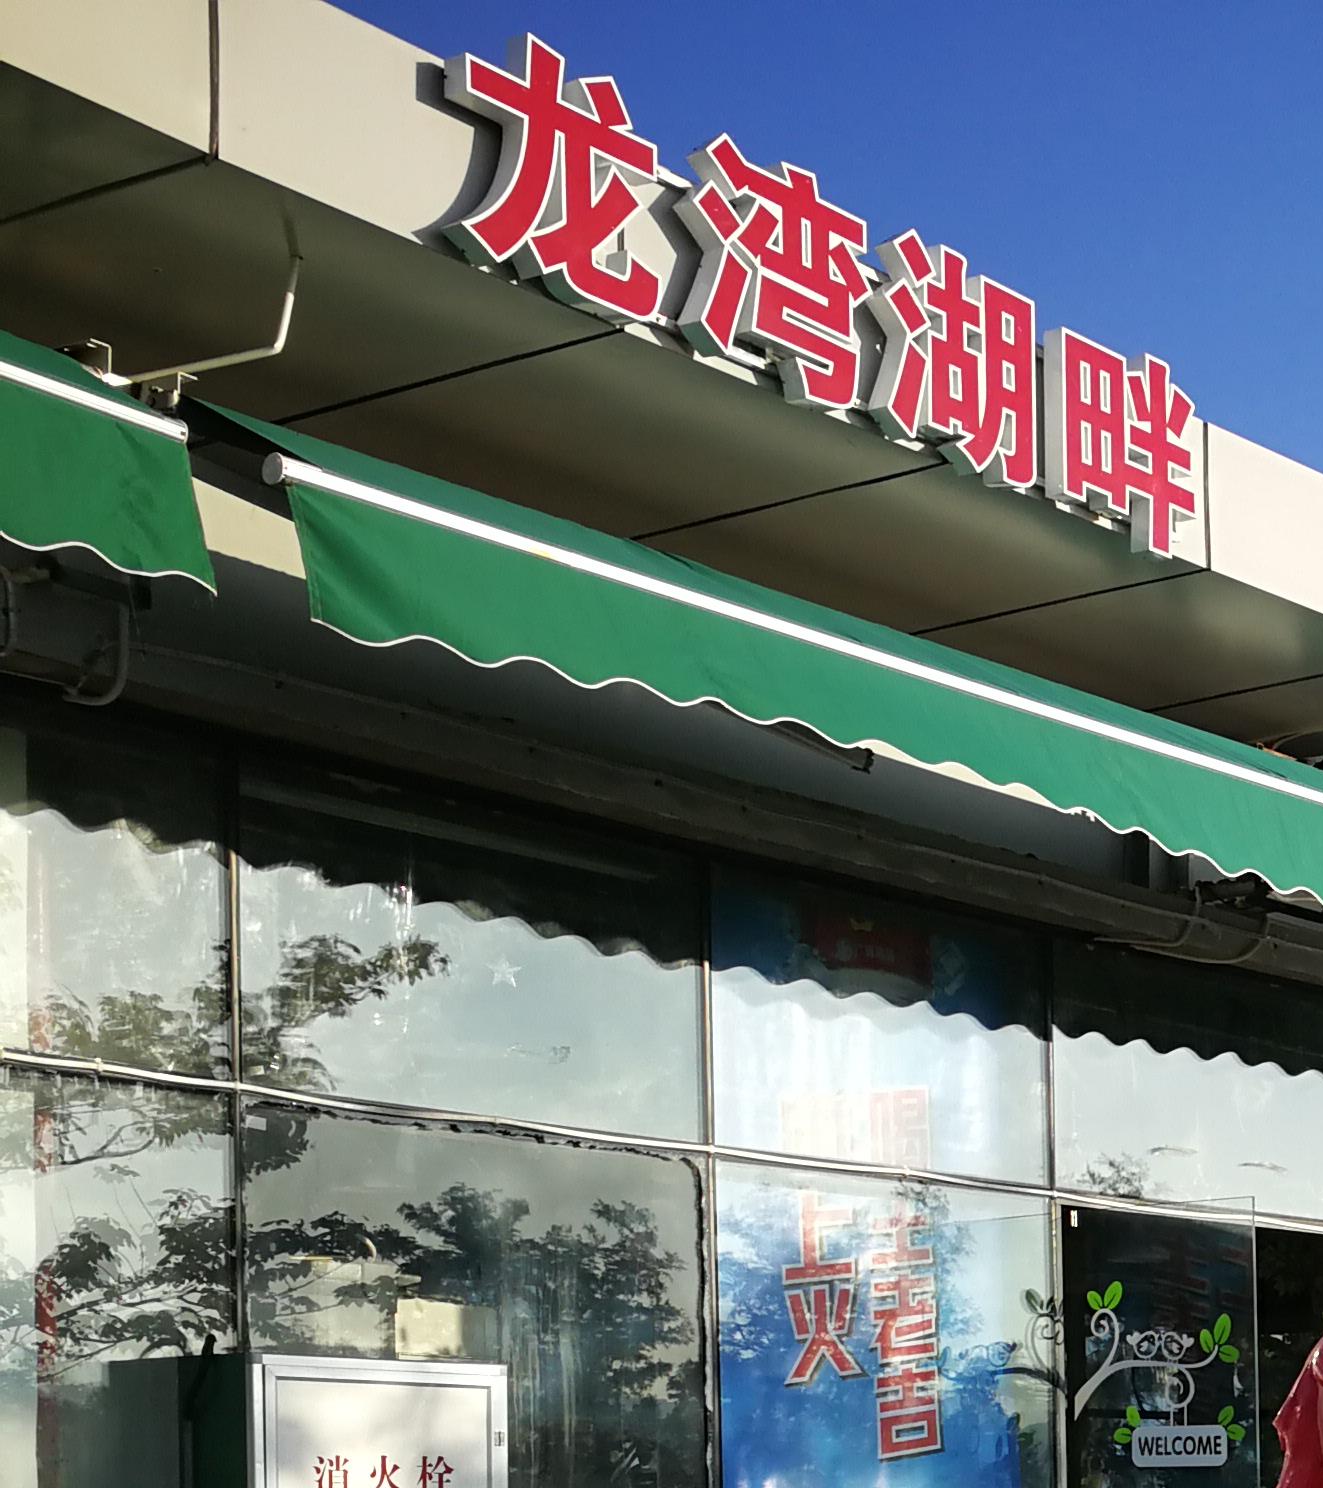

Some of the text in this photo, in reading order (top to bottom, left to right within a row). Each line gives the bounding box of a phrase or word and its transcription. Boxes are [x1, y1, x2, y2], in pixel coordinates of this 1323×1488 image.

[464, 32, 1197, 559] 龙湾湖畔
[780, 1100, 868, 1386] 上火
[1138, 1436, 1222, 1456] WELCOME
